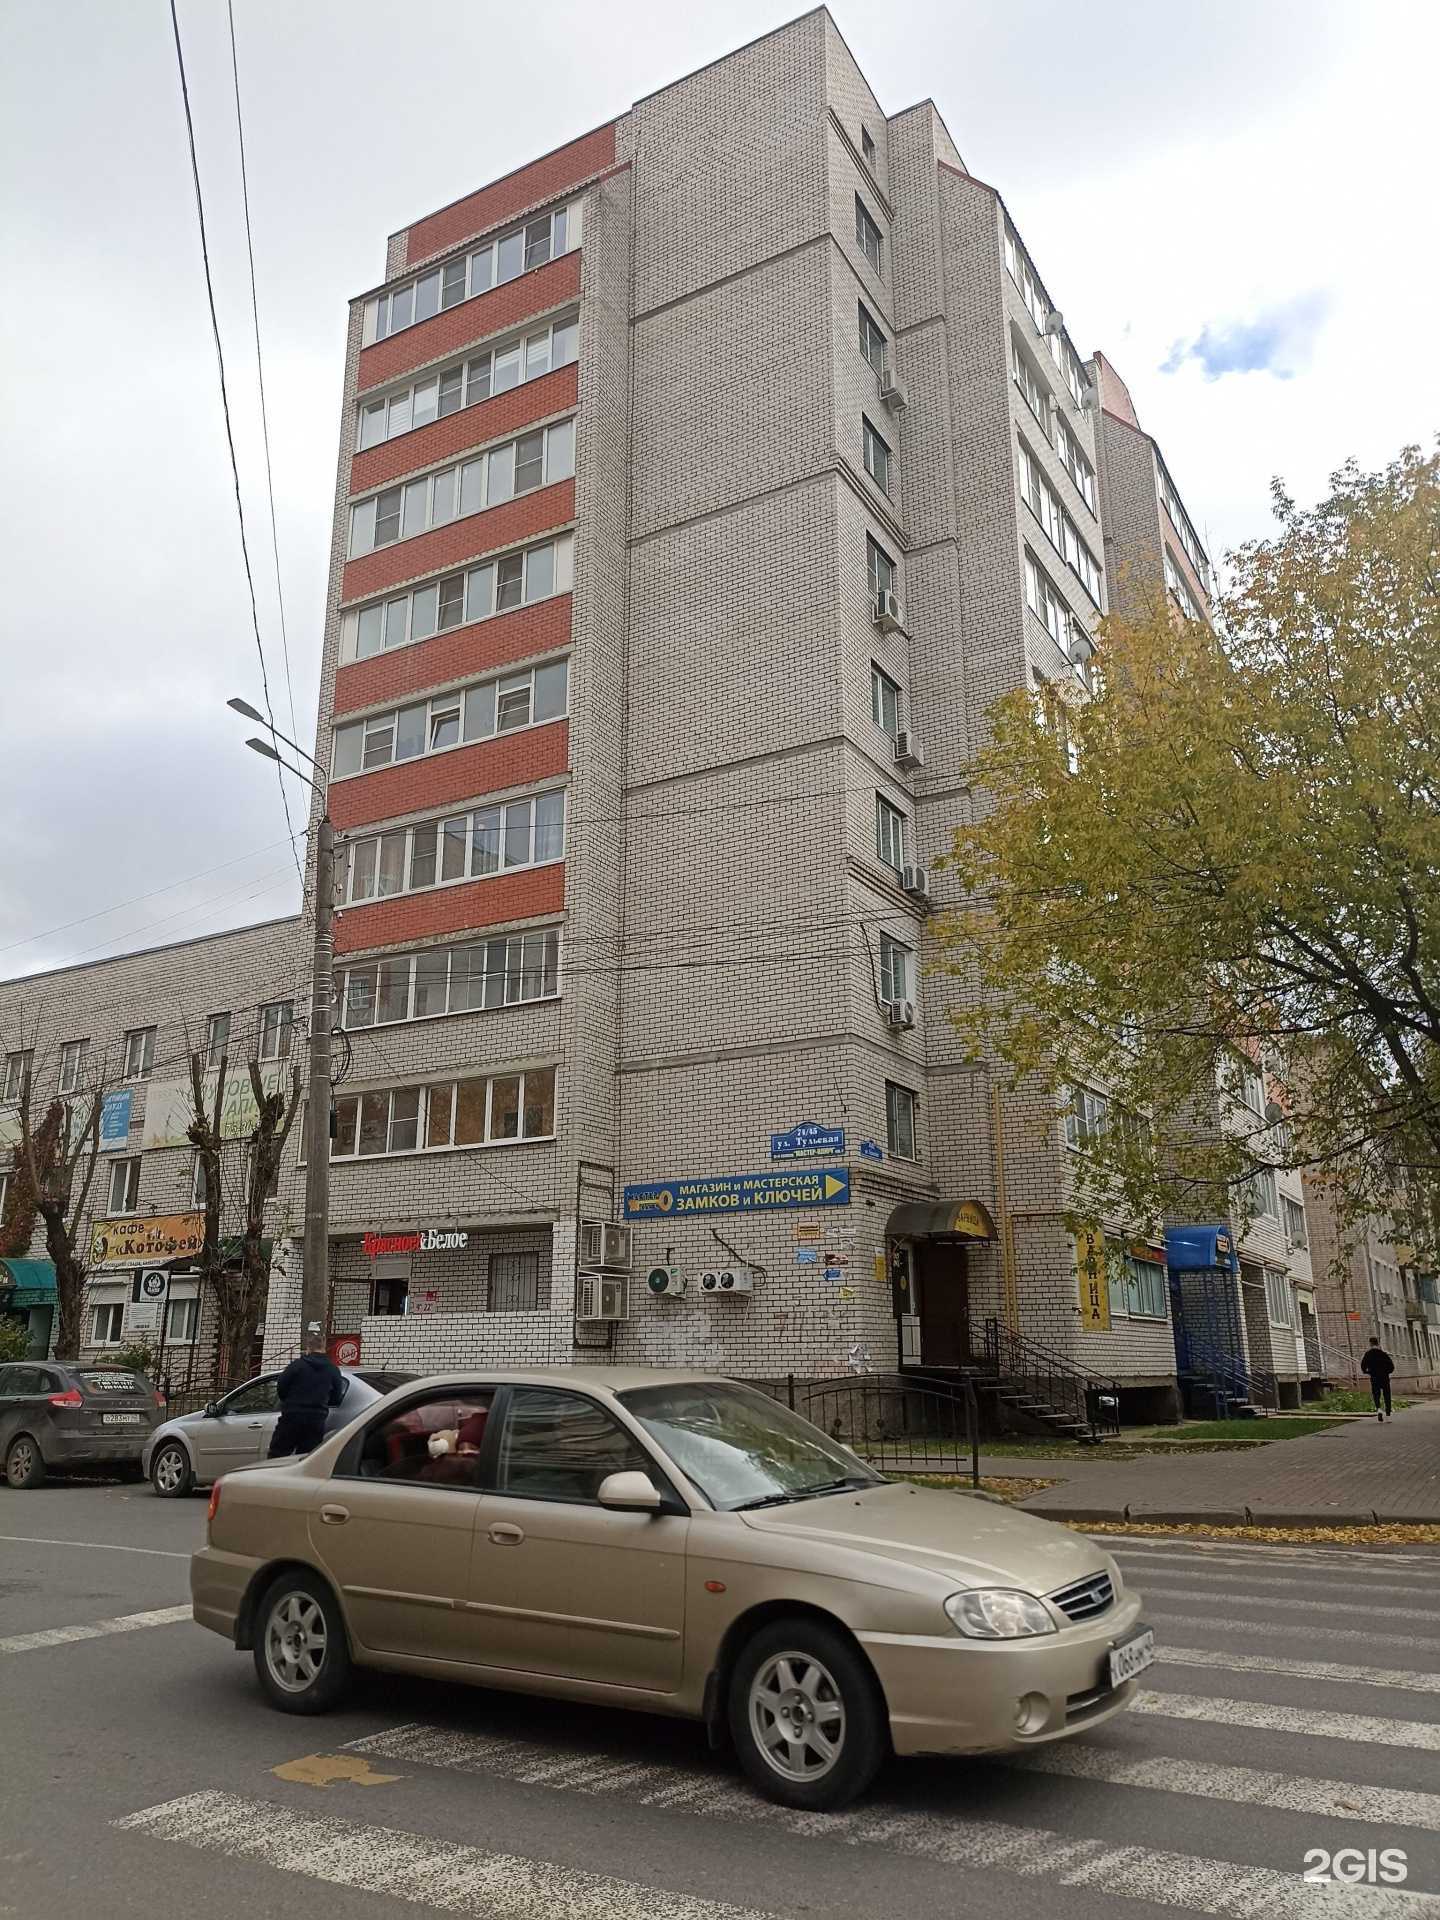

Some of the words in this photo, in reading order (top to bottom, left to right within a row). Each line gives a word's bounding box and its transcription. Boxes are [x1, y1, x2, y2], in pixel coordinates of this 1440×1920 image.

[795, 1136, 839, 1148] Тульская
[679, 1182, 731, 1195] МАГАЗИН
[733, 1183, 741, 1191] и
[743, 1175, 819, 1190] МАСТЕРСКАЯ
[676, 1194, 740, 1211] ЗАМКОВ
[743, 1197, 751, 1206] и
[754, 1186, 823, 1205] КЛЮЧЕЙ
[112, 1223, 145, 1236] кафе
